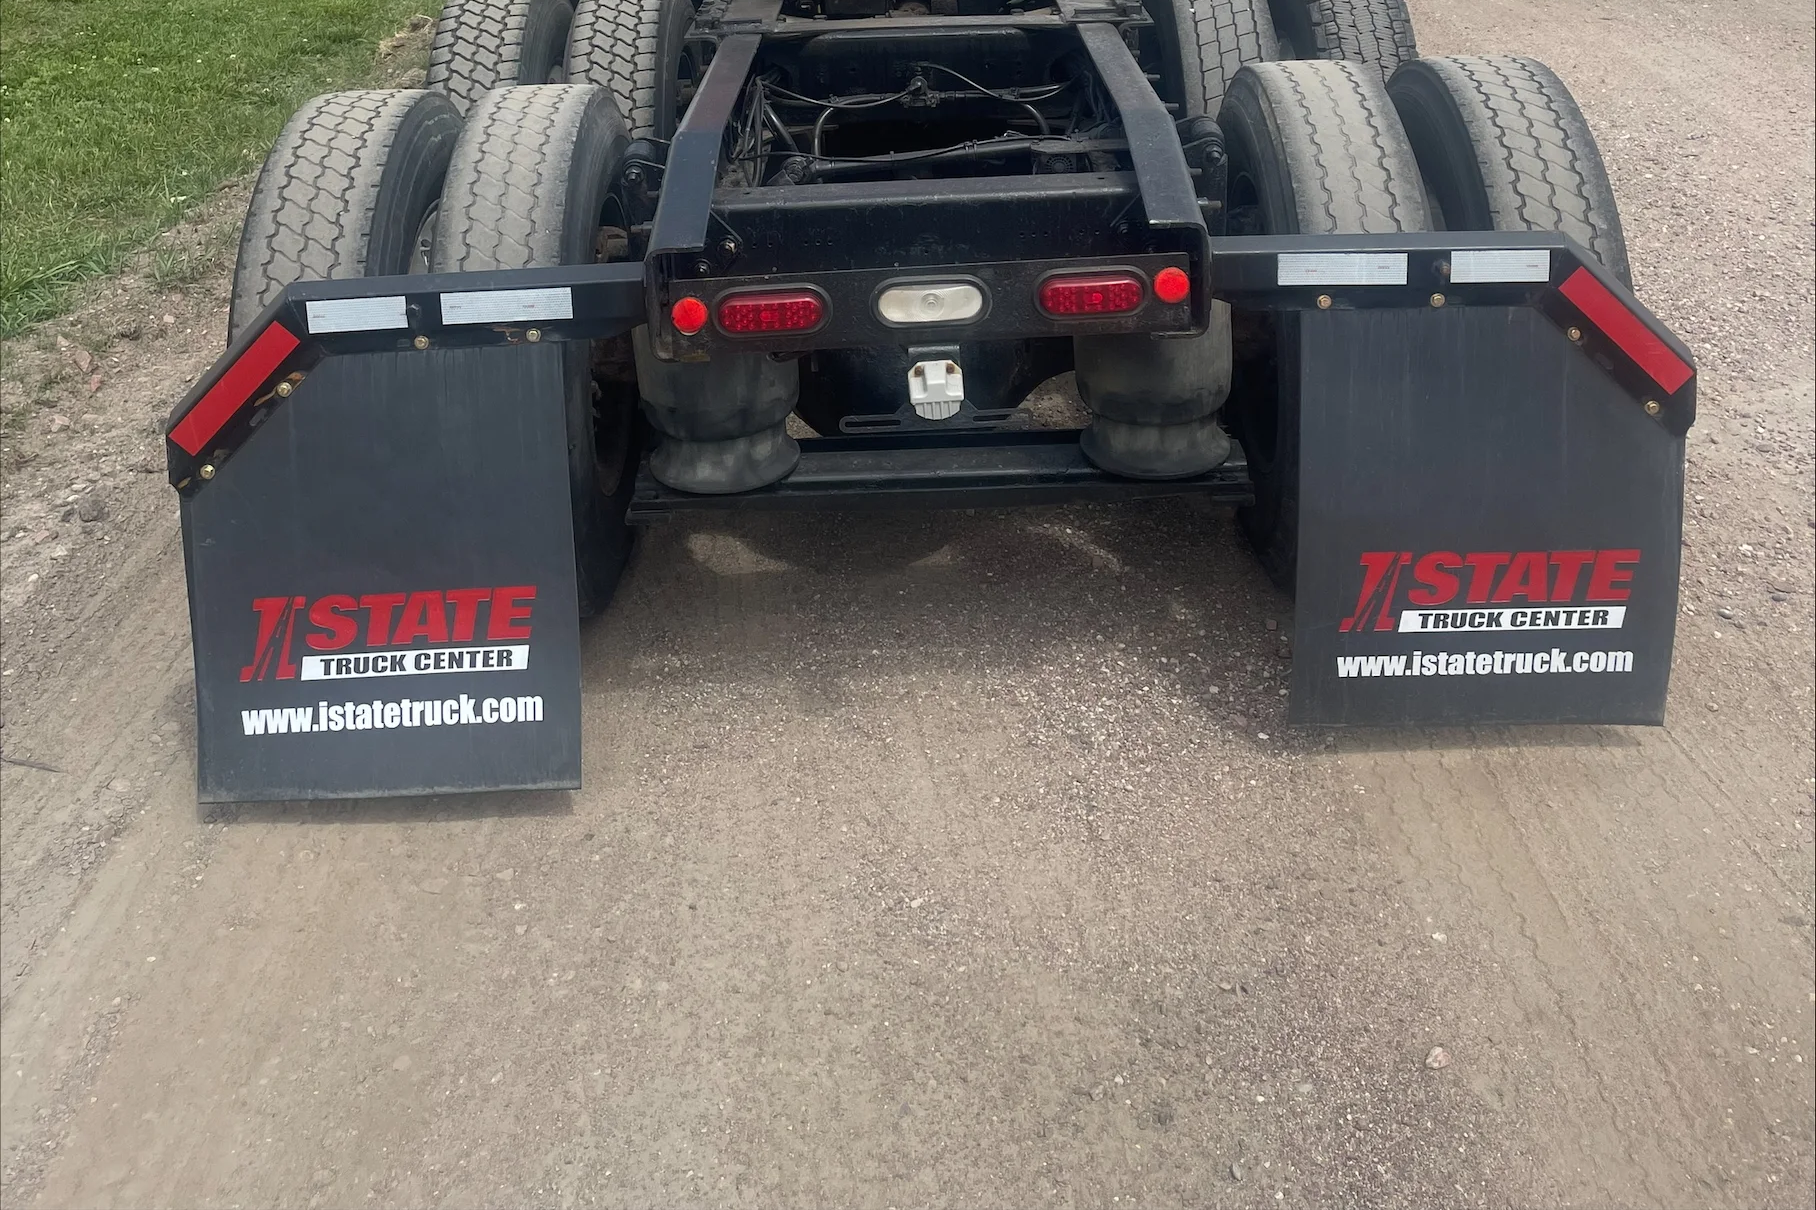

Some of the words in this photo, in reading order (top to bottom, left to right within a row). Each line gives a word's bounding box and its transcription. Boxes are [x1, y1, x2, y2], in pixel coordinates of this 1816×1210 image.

[1418, 612, 1505, 629] TRUCK
[1509, 609, 1610, 628] CENTER
[320, 655, 407, 676] TRUCK
[413, 648, 513, 672] CENTER
[1337, 648, 1634, 678] www.istatetruck.com
[241, 693, 544, 736] www.istatetruck.com
